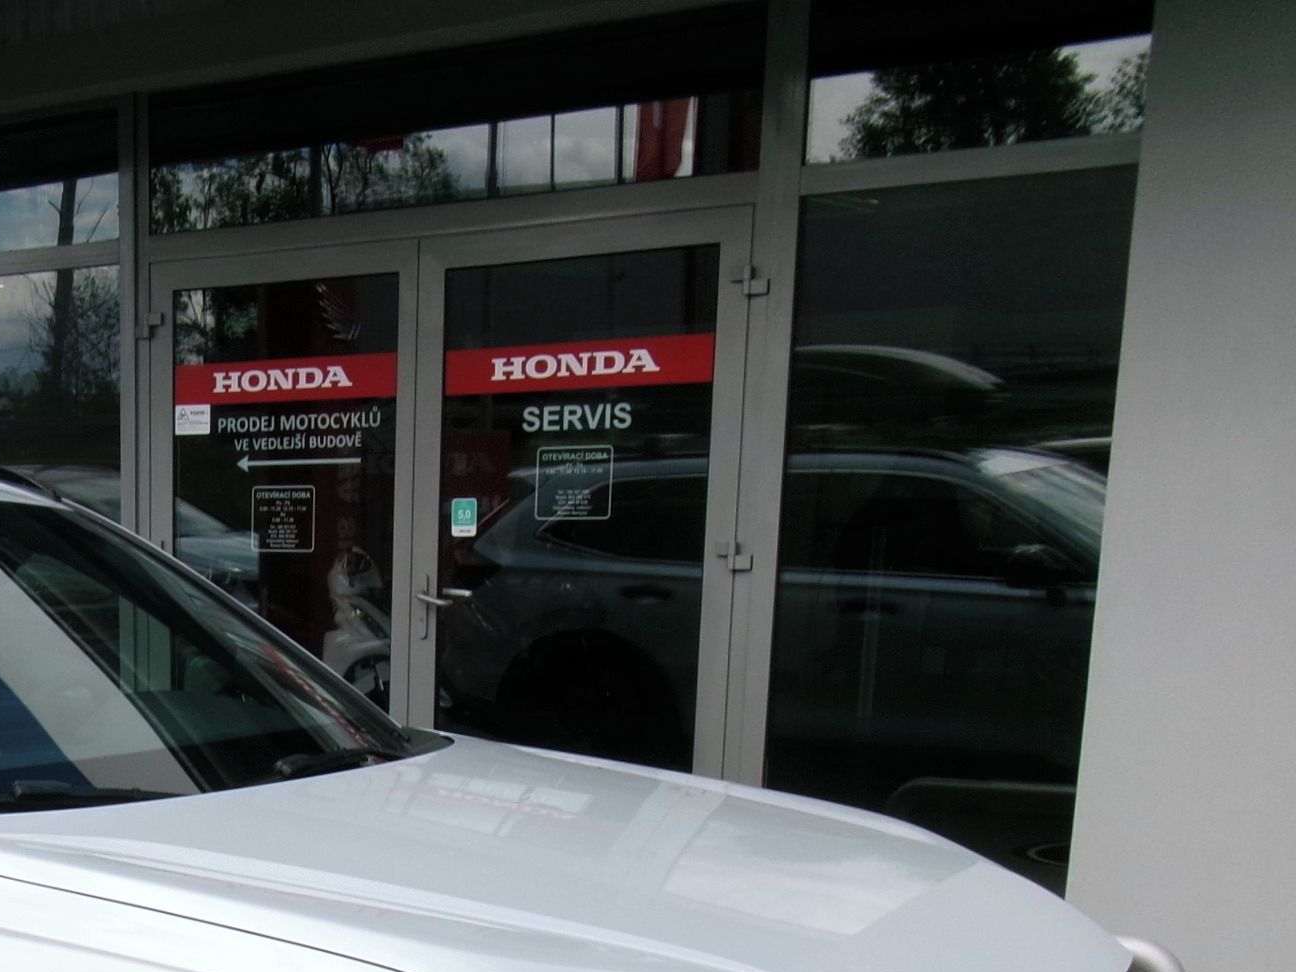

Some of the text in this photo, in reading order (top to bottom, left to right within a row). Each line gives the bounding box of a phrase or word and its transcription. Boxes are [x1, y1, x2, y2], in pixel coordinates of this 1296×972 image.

[491, 349, 660, 381] HONDA
[213, 366, 353, 393] HONDA
[217, 406, 381, 433] PRODEJ MOTOCYKLŮ
[522, 402, 633, 432] SERVIS
[234, 431, 362, 451] VE VEDLEJŠÍ BUDOVĚ
[585, 450, 608, 460] DOBA
[457, 509, 471, 520] 5,0
